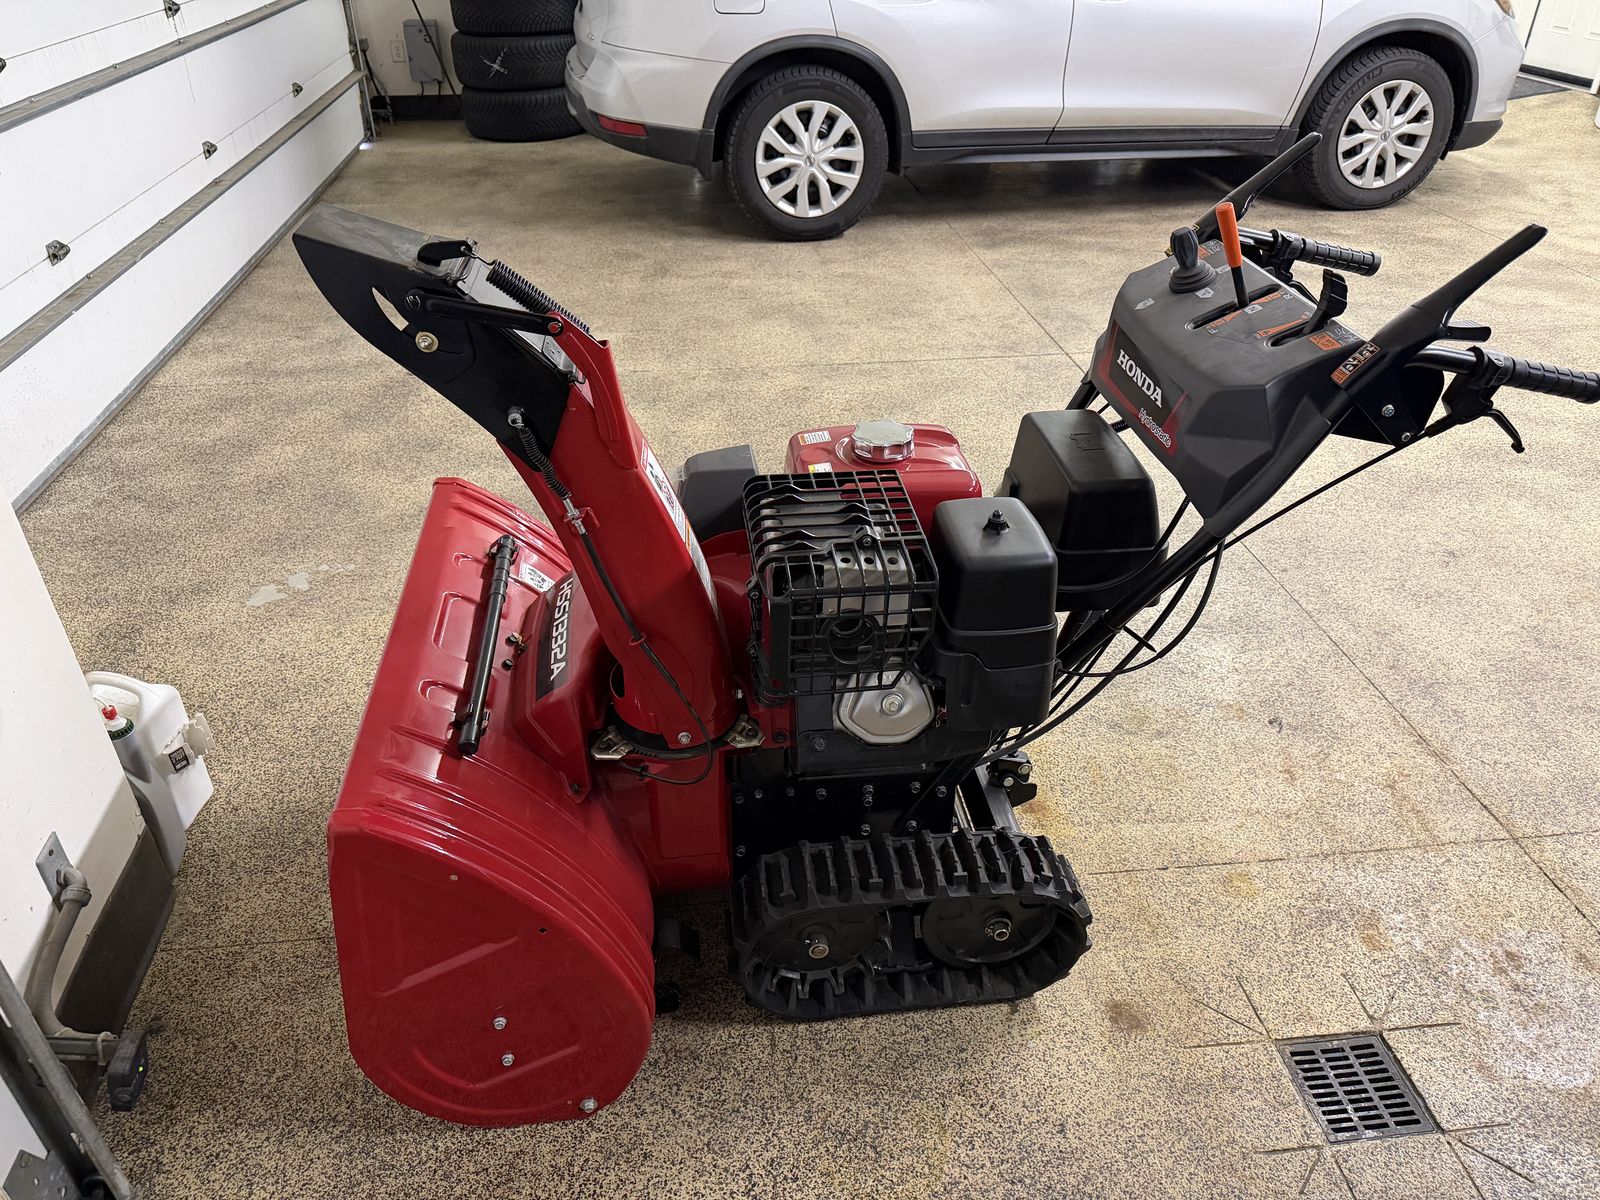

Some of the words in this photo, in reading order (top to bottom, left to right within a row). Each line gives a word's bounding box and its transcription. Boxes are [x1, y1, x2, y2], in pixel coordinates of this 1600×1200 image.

[1117, 349, 1162, 408] HONDA
[1138, 408, 1171, 448] Hydrostatic
[550, 578, 574, 680] HSS1332A
